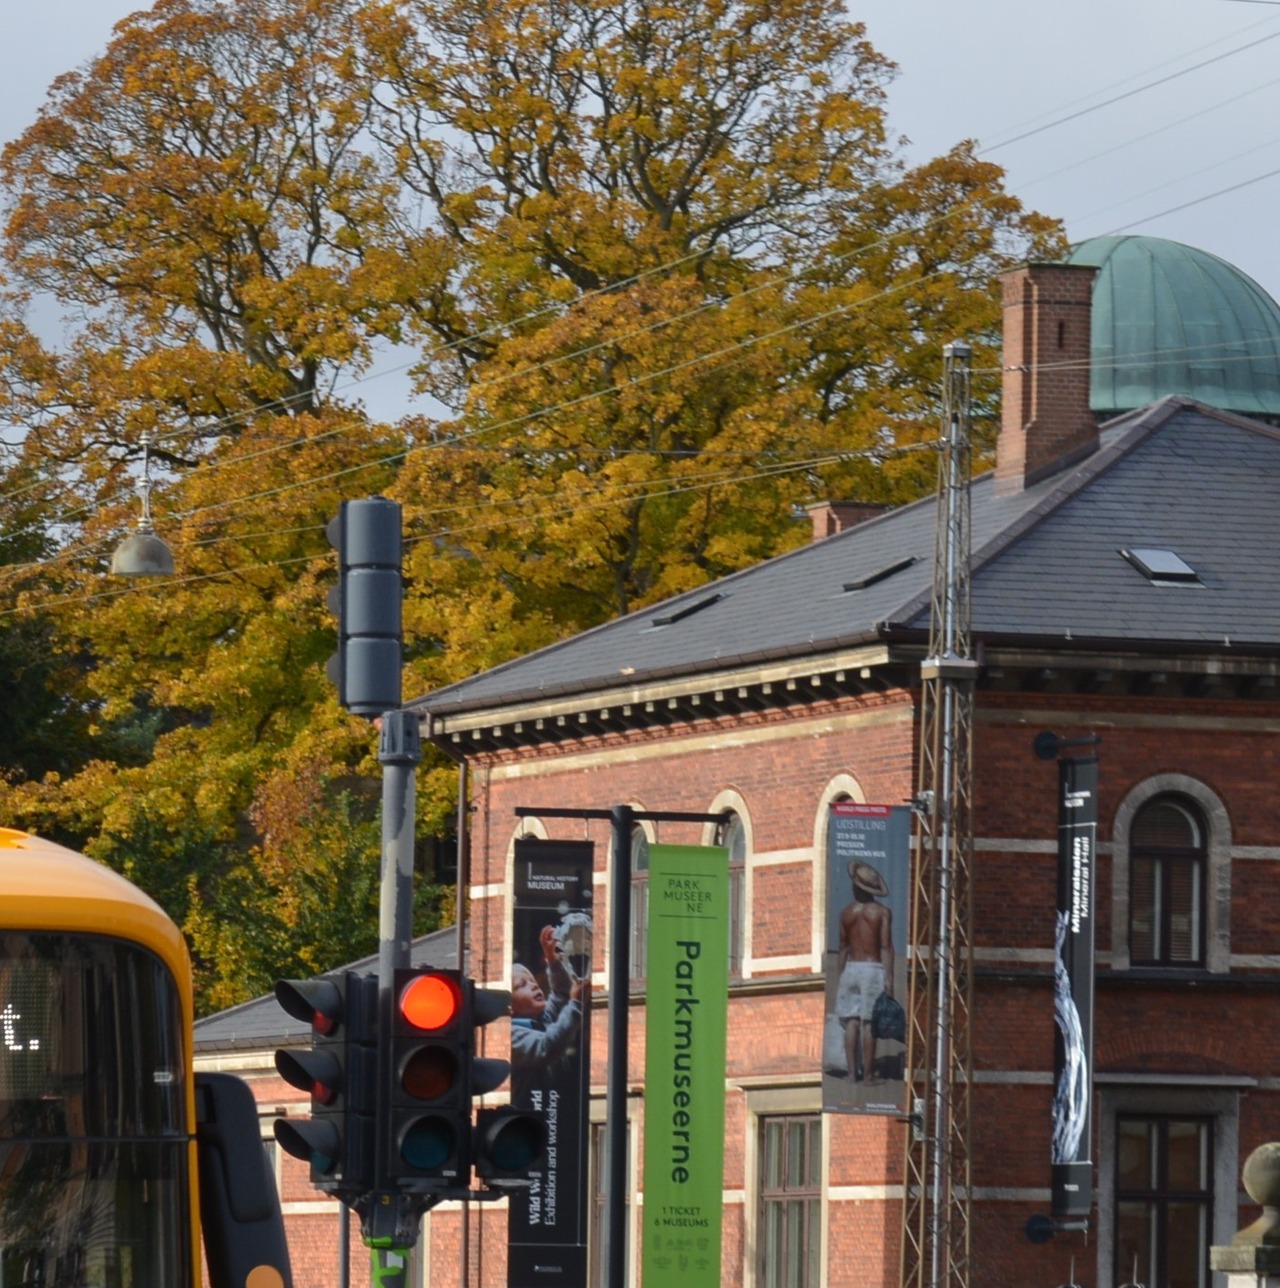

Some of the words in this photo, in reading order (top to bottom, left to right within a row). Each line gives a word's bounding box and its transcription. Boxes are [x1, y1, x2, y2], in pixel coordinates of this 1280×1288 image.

[836, 819, 886, 831] UDSTILLING
[527, 881, 565, 890] MUSEUM
[668, 879, 699, 890] PARK
[663, 890, 712, 902] MUSEER
[686, 903, 703, 913] NE
[671, 940, 701, 1184] Parkmuseerne
[546, 1090, 560, 1144] workshop
[546, 1147, 557, 1168] and
[544, 1171, 557, 1225] Exhibition
[669, 1206, 700, 1216] TICKET
[654, 1218, 660, 1227] 6
[663, 1218, 709, 1227] MUSEUMS
